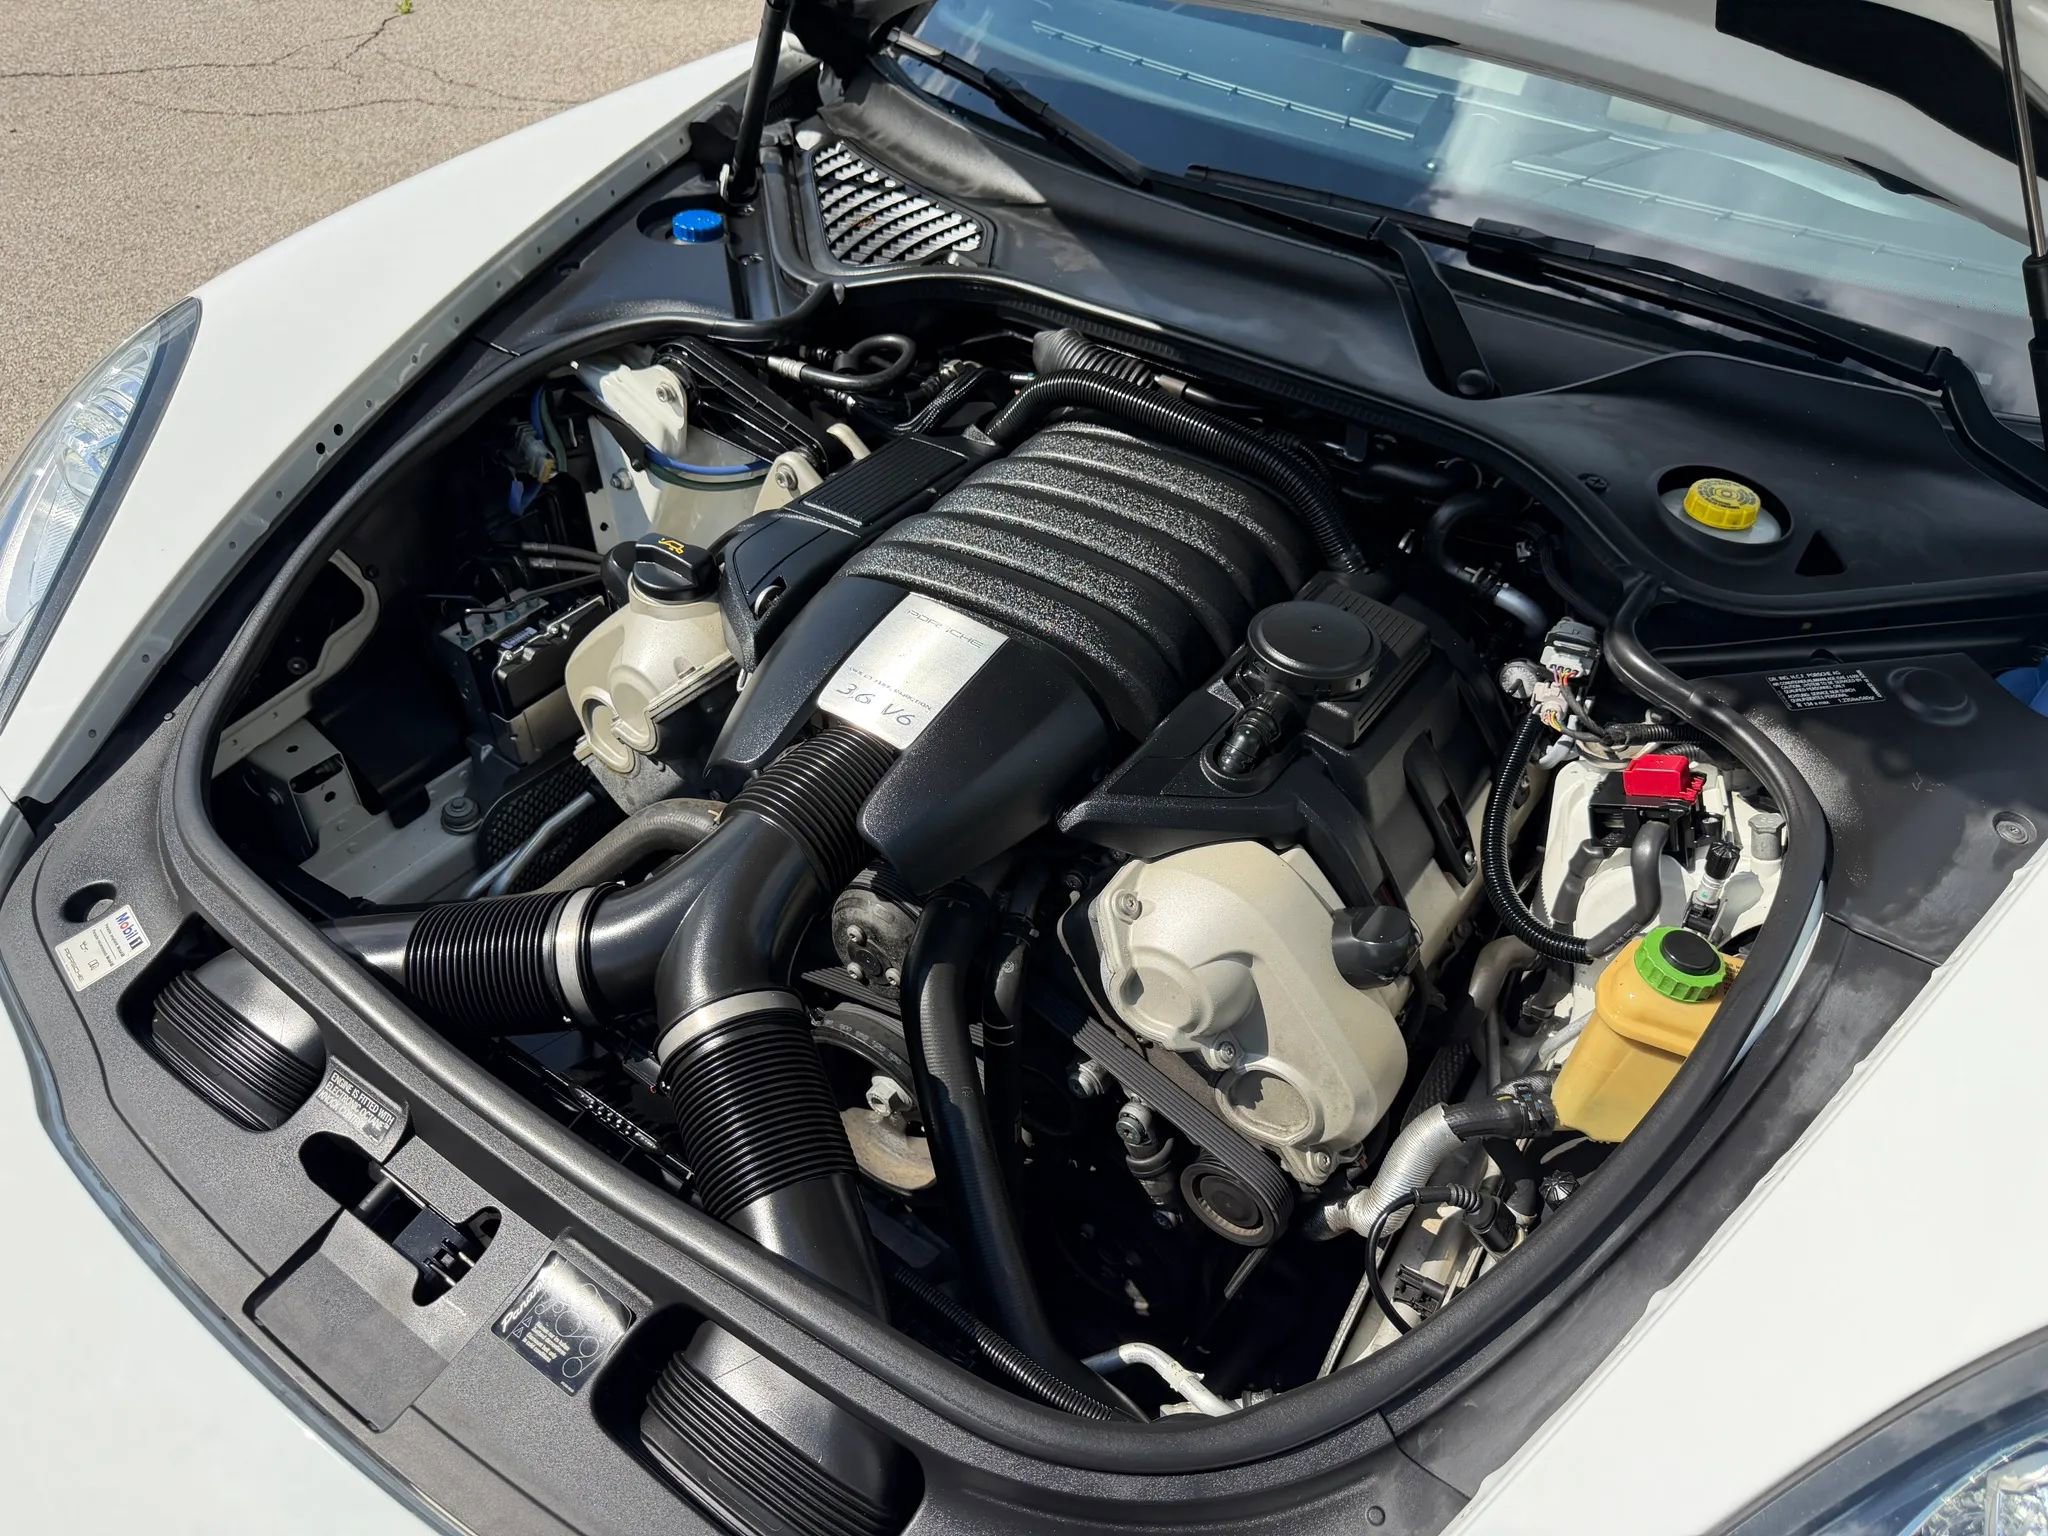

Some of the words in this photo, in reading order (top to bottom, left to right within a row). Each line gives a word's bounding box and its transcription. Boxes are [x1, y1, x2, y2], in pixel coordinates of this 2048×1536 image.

[907, 609, 983, 649] PORCHE
[881, 703, 915, 726] V6
[116, 912, 139, 941] Mobil
[129, 937, 144, 950] 1
[325, 1081, 361, 1112] ELECTRONIC
[331, 1072, 354, 1094] ENGINE
[352, 1088, 360, 1098] IS
[358, 1093, 380, 1113] FITTED
[378, 1107, 395, 1125] WITH
